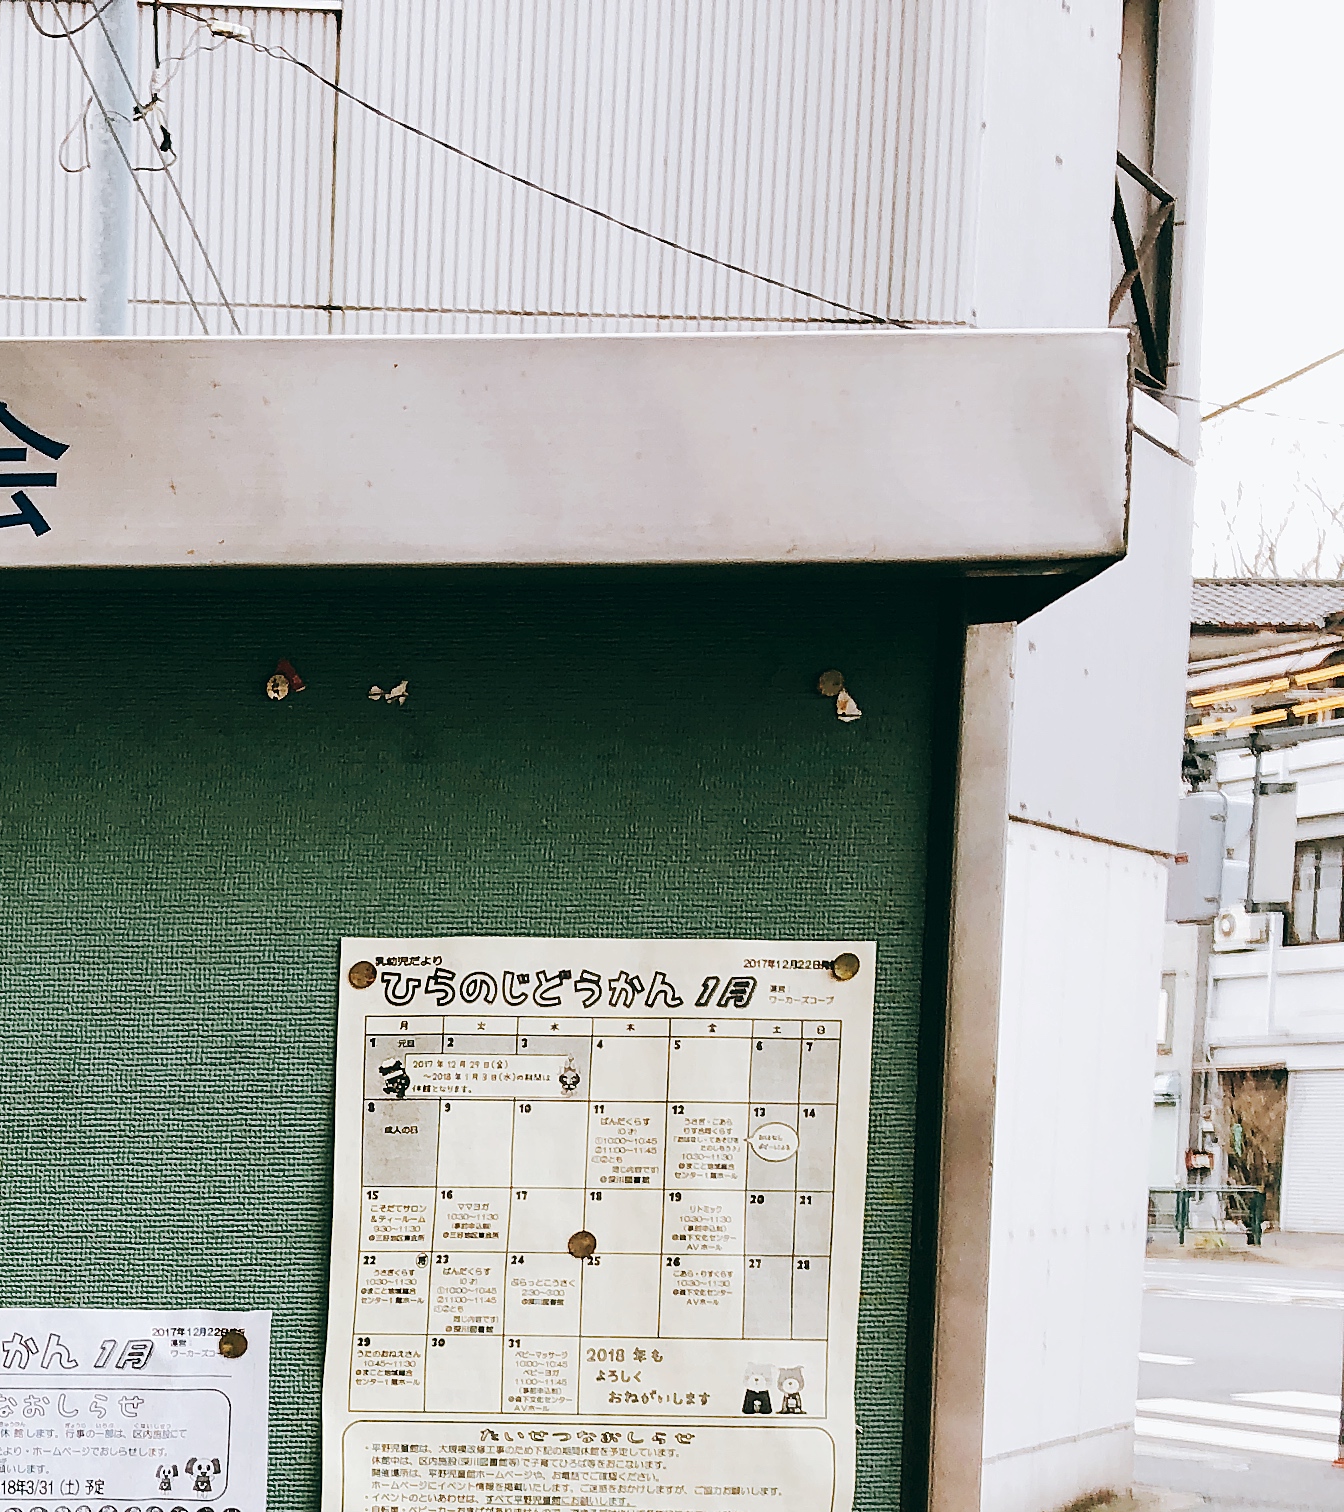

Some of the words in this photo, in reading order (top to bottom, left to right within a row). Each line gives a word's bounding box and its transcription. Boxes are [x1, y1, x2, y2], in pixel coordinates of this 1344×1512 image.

[381, 968, 683, 1008] ひらのじどうかん
[695, 976, 758, 1008] 1月
[370, 1038, 376, 1047] 1
[447, 1038, 454, 1047] 2
[596, 1040, 603, 1049] 4
[675, 1040, 681, 1049] 5
[806, 1042, 813, 1052] 7
[444, 1103, 451, 1112] 9
[519, 1104, 531, 1114] 10
[594, 1105, 604, 1114] 11
[672, 1106, 684, 1115] 12
[803, 1108, 815, 1118] 14
[366, 1191, 379, 1199] 15
[441, 1190, 453, 1199] 16
[516, 1191, 528, 1200] 17
[590, 1192, 602, 1201] 18
[669, 1193, 682, 1202] 19
[750, 1195, 765, 1204] 20
[800, 1196, 812, 1205] 21
[363, 1256, 376, 1265] 22
[436, 1255, 449, 1264] 23
[511, 1255, 525, 1265] 24
[587, 1256, 600, 1266] 25
[666, 1257, 681, 1267] 26
[749, 1259, 762, 1268] 27
[797, 1261, 810, 1270] 28
[152, 1328, 245, 1337] 2017年12月22日
[357, 1338, 371, 1347] 29
[431, 1338, 445, 1347] 30
[508, 1339, 521, 1348] 31
[94, 1339, 155, 1370] 1月
[596, 1370, 642, 1383] よろしく
[609, 1390, 711, 1405] おねがいします
[481, 1429, 696, 1444] たいせつなおしらせ
